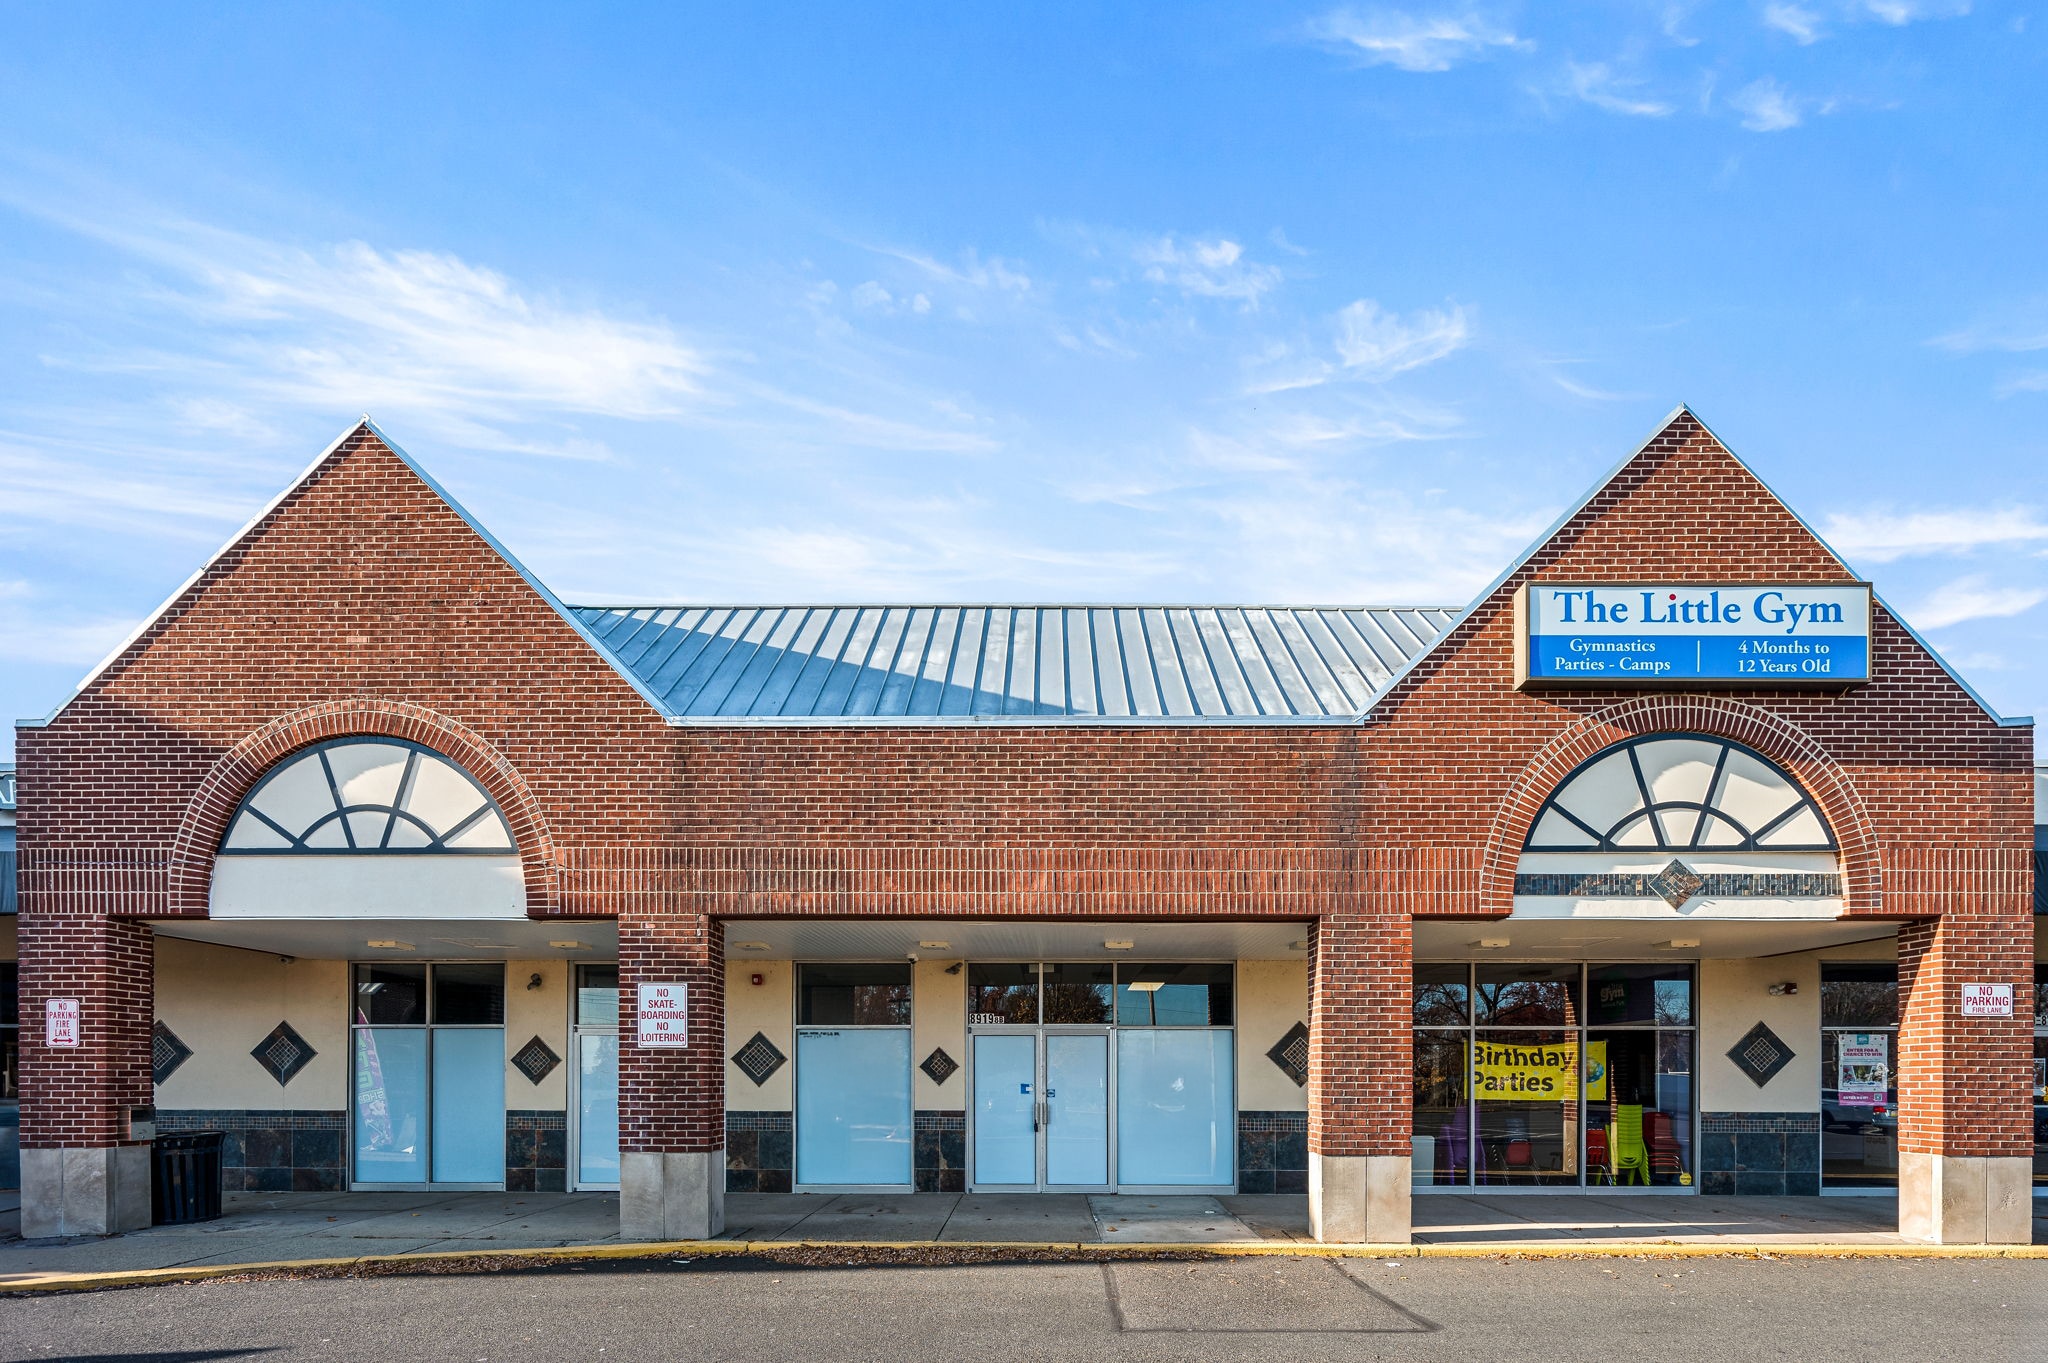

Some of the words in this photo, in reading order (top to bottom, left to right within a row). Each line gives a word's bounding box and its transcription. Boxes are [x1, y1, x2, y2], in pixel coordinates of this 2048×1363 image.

[1553, 590, 1629, 624] The
[1639, 590, 1742, 624] Little
[1753, 591, 1844, 634] Gym
[1569, 638, 1656, 655] Gymnastics
[1738, 640, 1747, 654] 4
[1751, 640, 1811, 655] Months
[1815, 641, 1830, 655] to
[1555, 656, 1605, 671] Parties
[1619, 657, 1671, 675] Camps
[1738, 659, 1756, 673] 12
[1760, 659, 1797, 674] Years
[1800, 659, 1831, 674] Old
[656, 988, 669, 998] NO
[1979, 986, 1993, 996] NO
[58, 1002, 68, 1010] NO
[648, 999, 677, 1009] SKATE-
[1966, 996, 2009, 1006] PARKING
[49, 1011, 77, 1019] PARKING
[641, 1010, 685, 1020] BOARDING
[970, 1013, 994, 1024] 8919
[55, 1020, 70, 1028] FIRE
[656, 1021, 669, 1031] NO
[54, 1029, 71, 1037] LANE
[641, 1033, 685, 1042] LOITERING
[1474, 1045, 1575, 1072] Birthday
[1474, 1071, 1554, 1092] Parties
